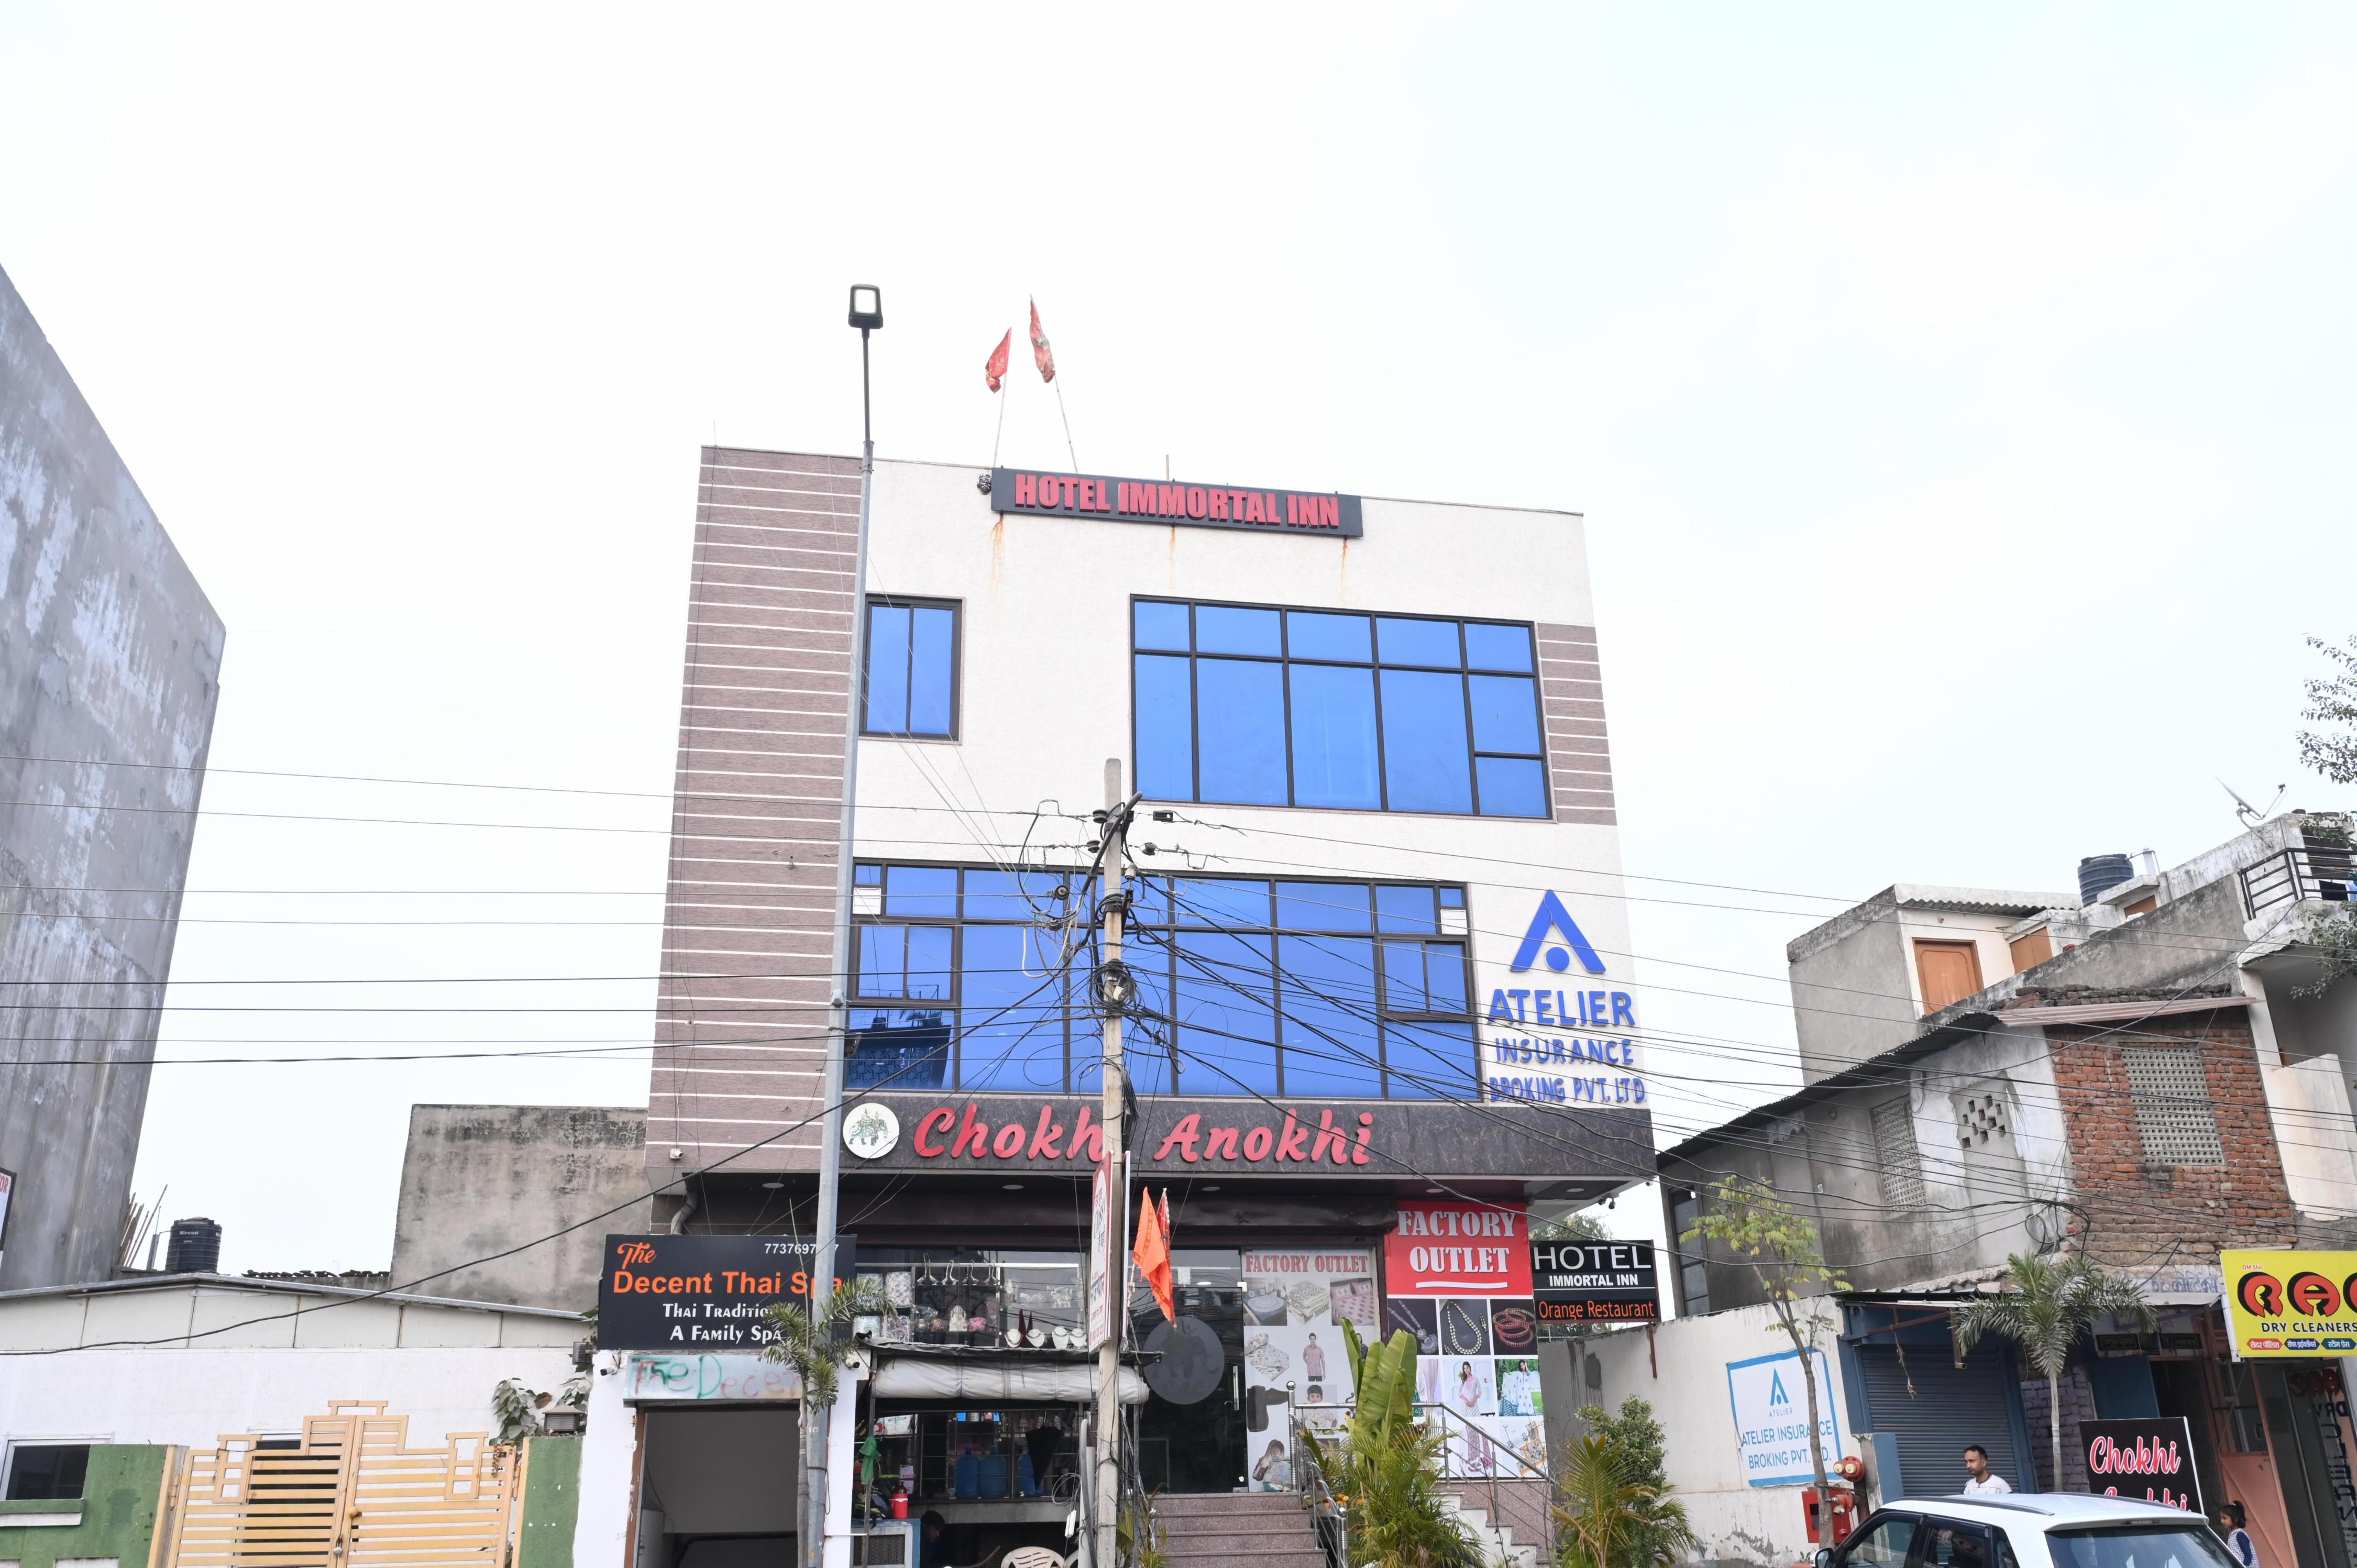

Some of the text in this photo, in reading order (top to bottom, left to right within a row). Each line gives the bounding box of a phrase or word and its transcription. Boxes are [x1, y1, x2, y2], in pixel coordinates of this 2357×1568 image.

[1015, 473, 1339, 528] HOTEL IMMORTAL INN
[1488, 988, 1636, 1026] ATELIER
[1495, 1037, 1634, 1065] INSURANCE
[1489, 1077, 1566, 1103] BROKING
[913, 1102, 1373, 1165] Chokh Anokhi
[1397, 1210, 1518, 1237] FACTORY
[617, 1242, 839, 1270] The 77376977
[1245, 1255, 1368, 1273] FACTORY OUTLET
[1409, 1247, 1510, 1273] OUTLET
[1534, 1245, 1651, 1270] HOTEL
[613, 1271, 712, 1294] Decent
[722, 1271, 781, 1294] Thai
[1549, 1274, 1638, 1287] IMMORTAL INN
[703, 1302, 775, 1318] Traditio
[1539, 1300, 1655, 1320] Orange Restaurant
[669, 1325, 684, 1341] A
[2261, 1322, 2357, 1332] DRY CLEANERS
[697, 1355, 803, 1399] Decen
[1769, 1407, 1793, 1417] ATELIER
[1742, 1420, 1833, 1446] ATELIER INSURACE
[1748, 1450, 1789, 1469] BROKING
[1791, 1449, 1810, 1465] PVT.
[2089, 1436, 2181, 1475] Chokhi
